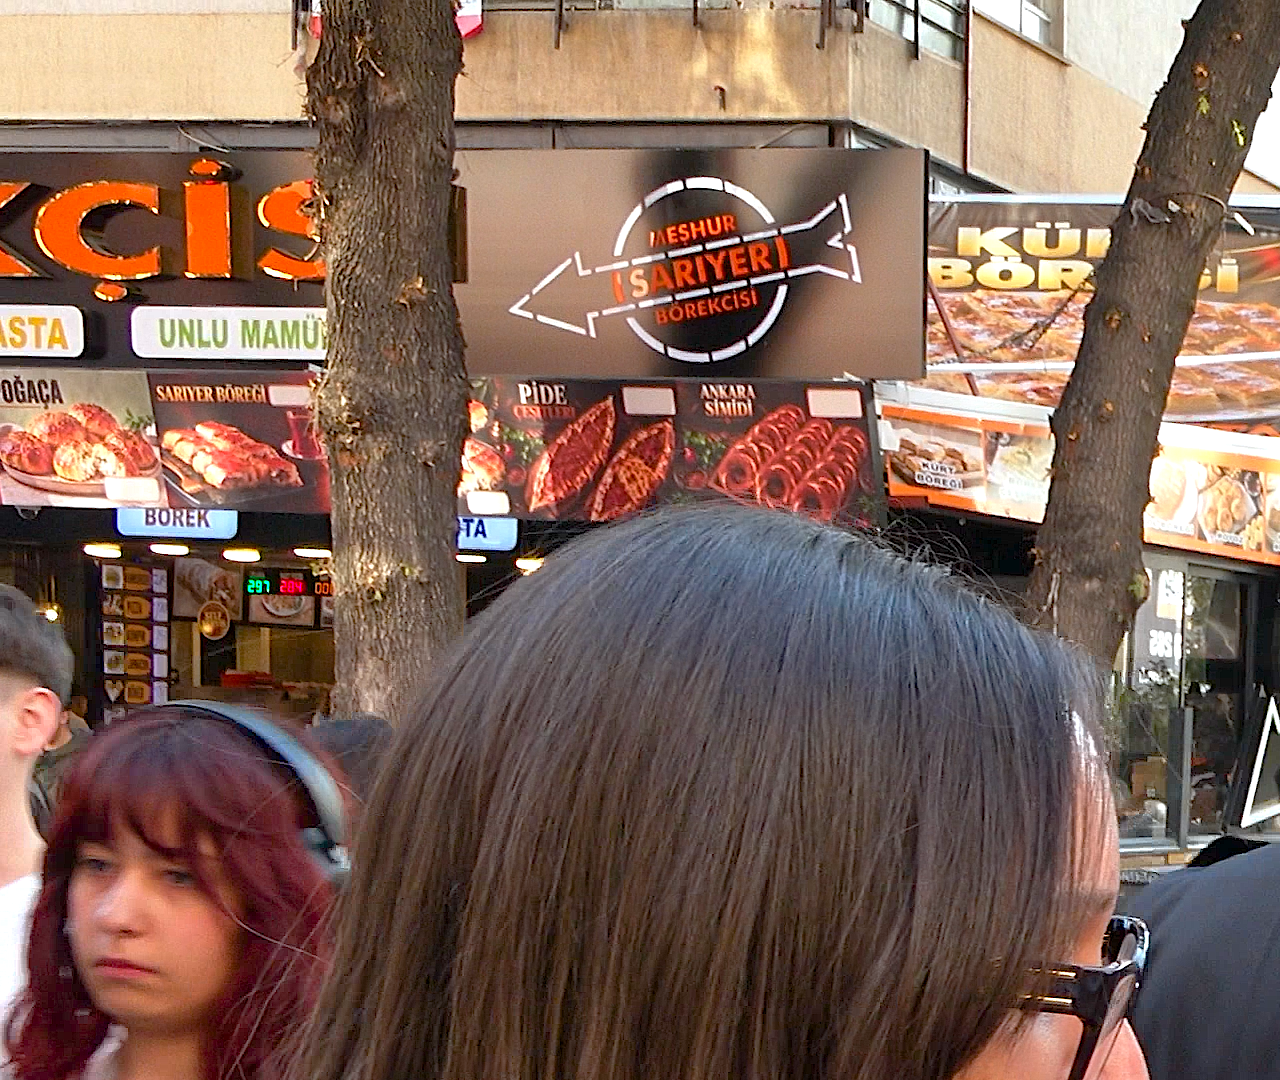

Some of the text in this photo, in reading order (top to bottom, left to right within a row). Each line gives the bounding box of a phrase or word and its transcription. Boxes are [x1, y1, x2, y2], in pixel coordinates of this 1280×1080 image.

[629, 241, 773, 298] SARIYER
[158, 313, 326, 351] UNLU MAMÜ
[156, 383, 267, 403] SARIYER BÖREĞİ
[517, 380, 568, 406] PİDE
[700, 383, 756, 400] ANKARA
[704, 397, 754, 417] SİMİDİ
[247, 580, 271, 594] 297
